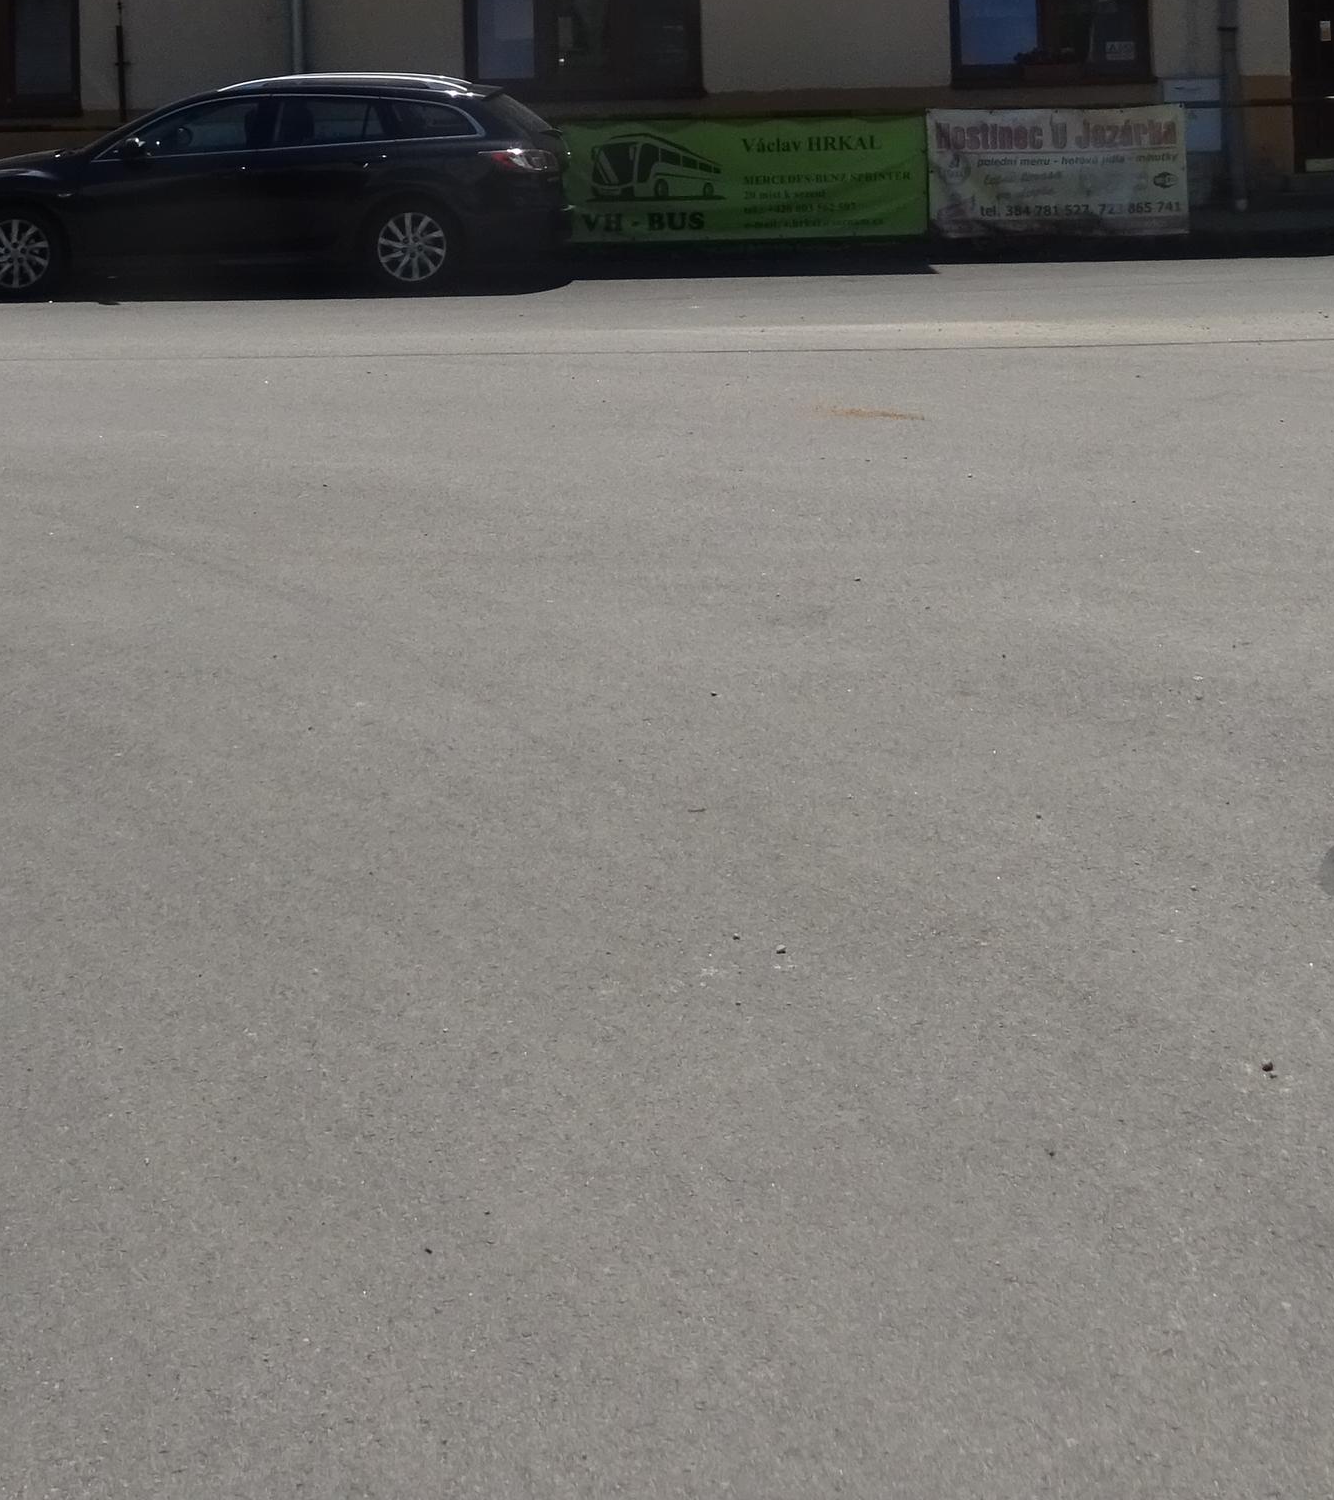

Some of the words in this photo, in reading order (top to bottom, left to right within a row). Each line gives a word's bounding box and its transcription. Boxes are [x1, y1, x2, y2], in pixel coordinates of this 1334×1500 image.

[935, 121, 1043, 150] Hostinec
[1050, 119, 1067, 149] U
[742, 137, 802, 153] Václav
[807, 135, 882, 152] HRKAL
[1020, 157, 1051, 167] menu
[980, 204, 1001, 217] tel.
[1034, 204, 1058, 217] 781
[1157, 201, 1181, 213] 741
[581, 212, 623, 232] VH
[648, 211, 705, 230] BUS
